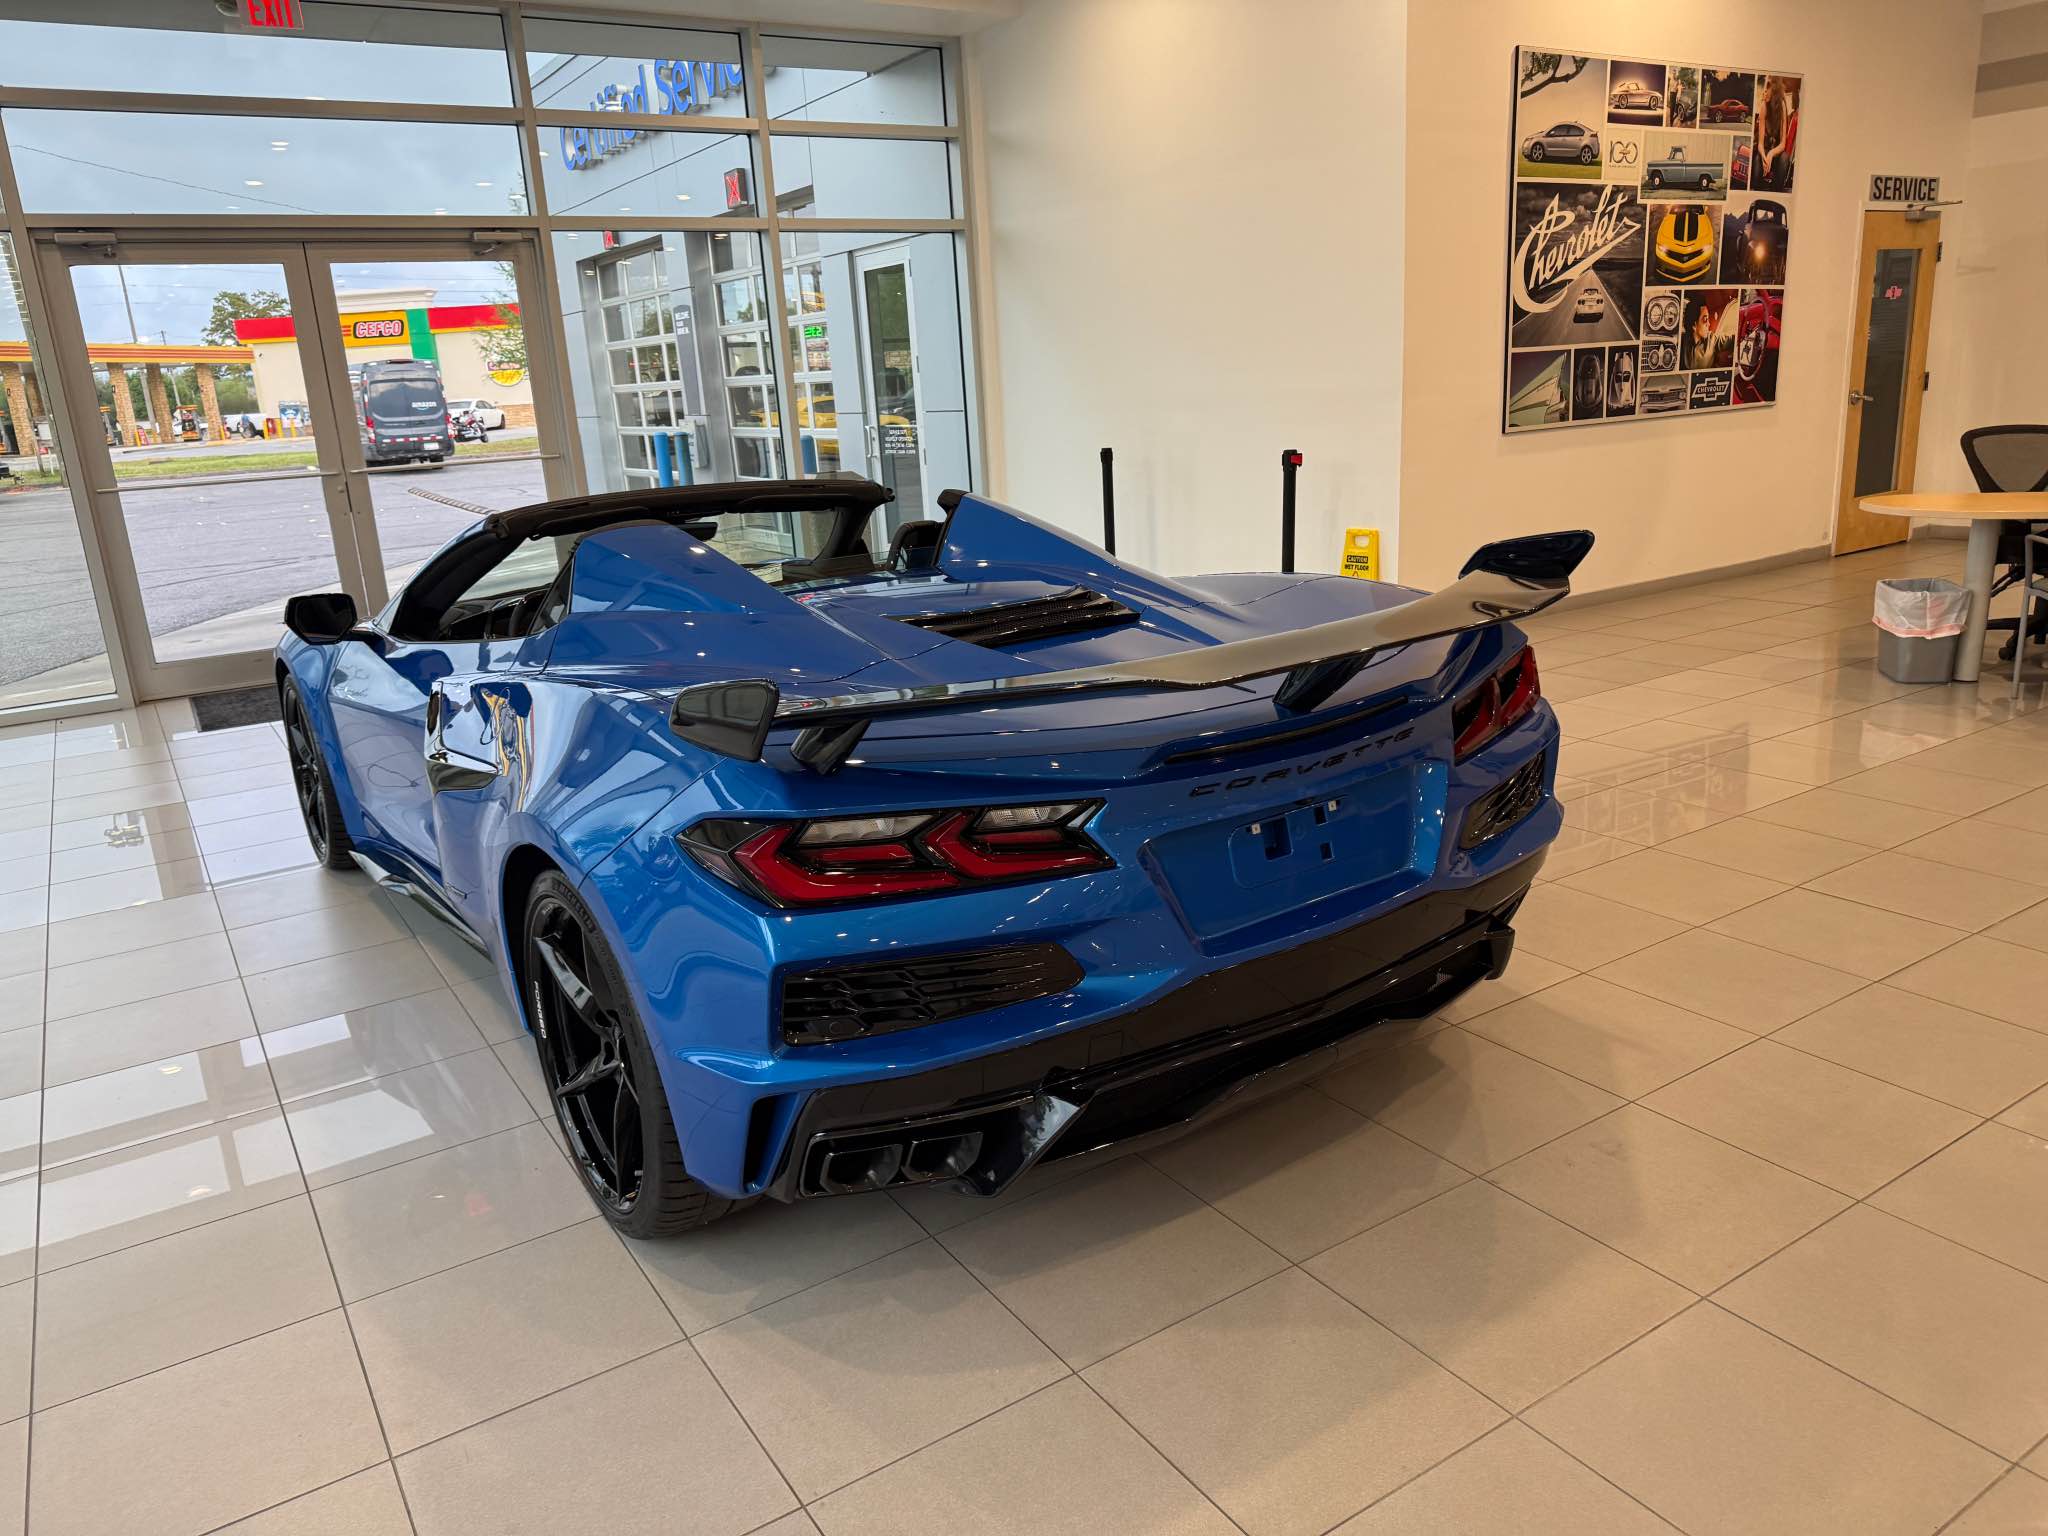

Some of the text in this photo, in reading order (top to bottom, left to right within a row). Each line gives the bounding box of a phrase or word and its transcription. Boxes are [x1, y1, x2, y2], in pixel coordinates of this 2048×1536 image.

[1872, 176, 1937, 200] SERVICE
[1513, 184, 1641, 313] Chevrolet
[355, 320, 403, 338] CEFCO
[1696, 385, 1726, 394] CHEVROLET
[1189, 726, 1416, 797] CORVETTE
